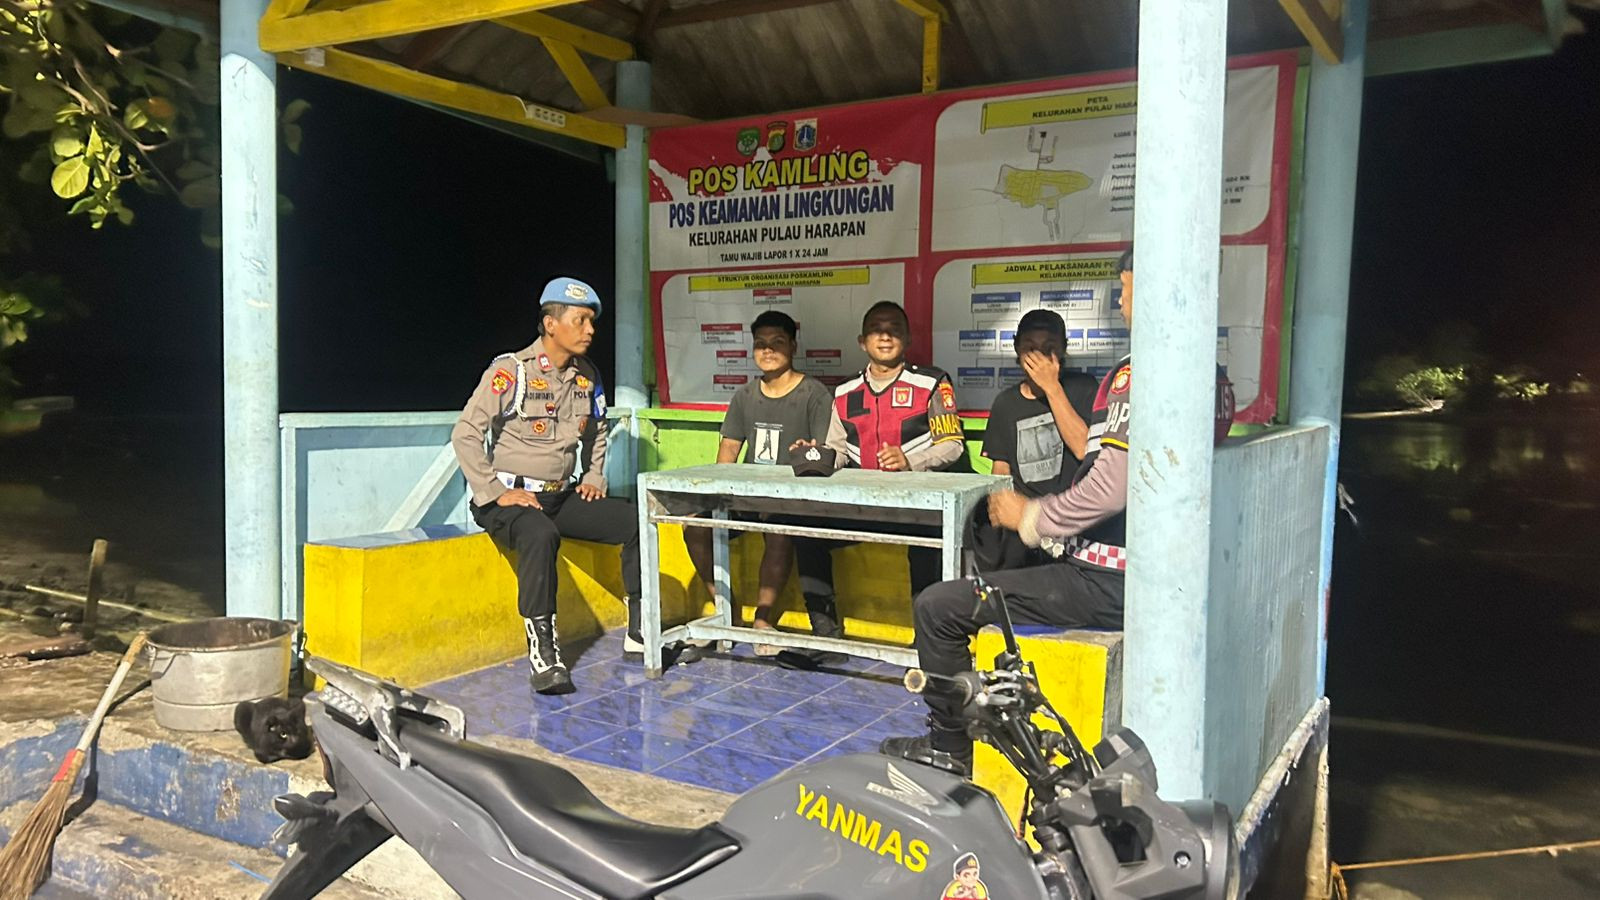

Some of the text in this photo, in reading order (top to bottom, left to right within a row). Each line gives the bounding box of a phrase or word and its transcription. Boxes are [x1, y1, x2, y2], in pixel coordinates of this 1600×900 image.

[1032, 101, 1137, 119] KELURAHAN PULAU HARA
[1087, 96, 1108, 104] PETA
[688, 150, 869, 195] POS KAMLING
[669, 184, 894, 228] POS KEAMANAN LINGKUNGAN
[689, 221, 866, 246] KELURAHAN PULAU HARAPAN
[720, 252, 738, 262] TAMU
[740, 251, 762, 262] WAJIB
[764, 250, 788, 260] LAPOR
[795, 250, 800, 258] X
[802, 249, 812, 258] 24
[813, 248, 828, 258] JAM
[751, 273, 790, 281] ORGANISASI
[790, 271, 834, 279] POSKAMLING
[1040, 262, 1100, 271] PELAKSANAAN
[930, 414, 961, 437] PAMA
[795, 784, 930, 873] YANMAS
